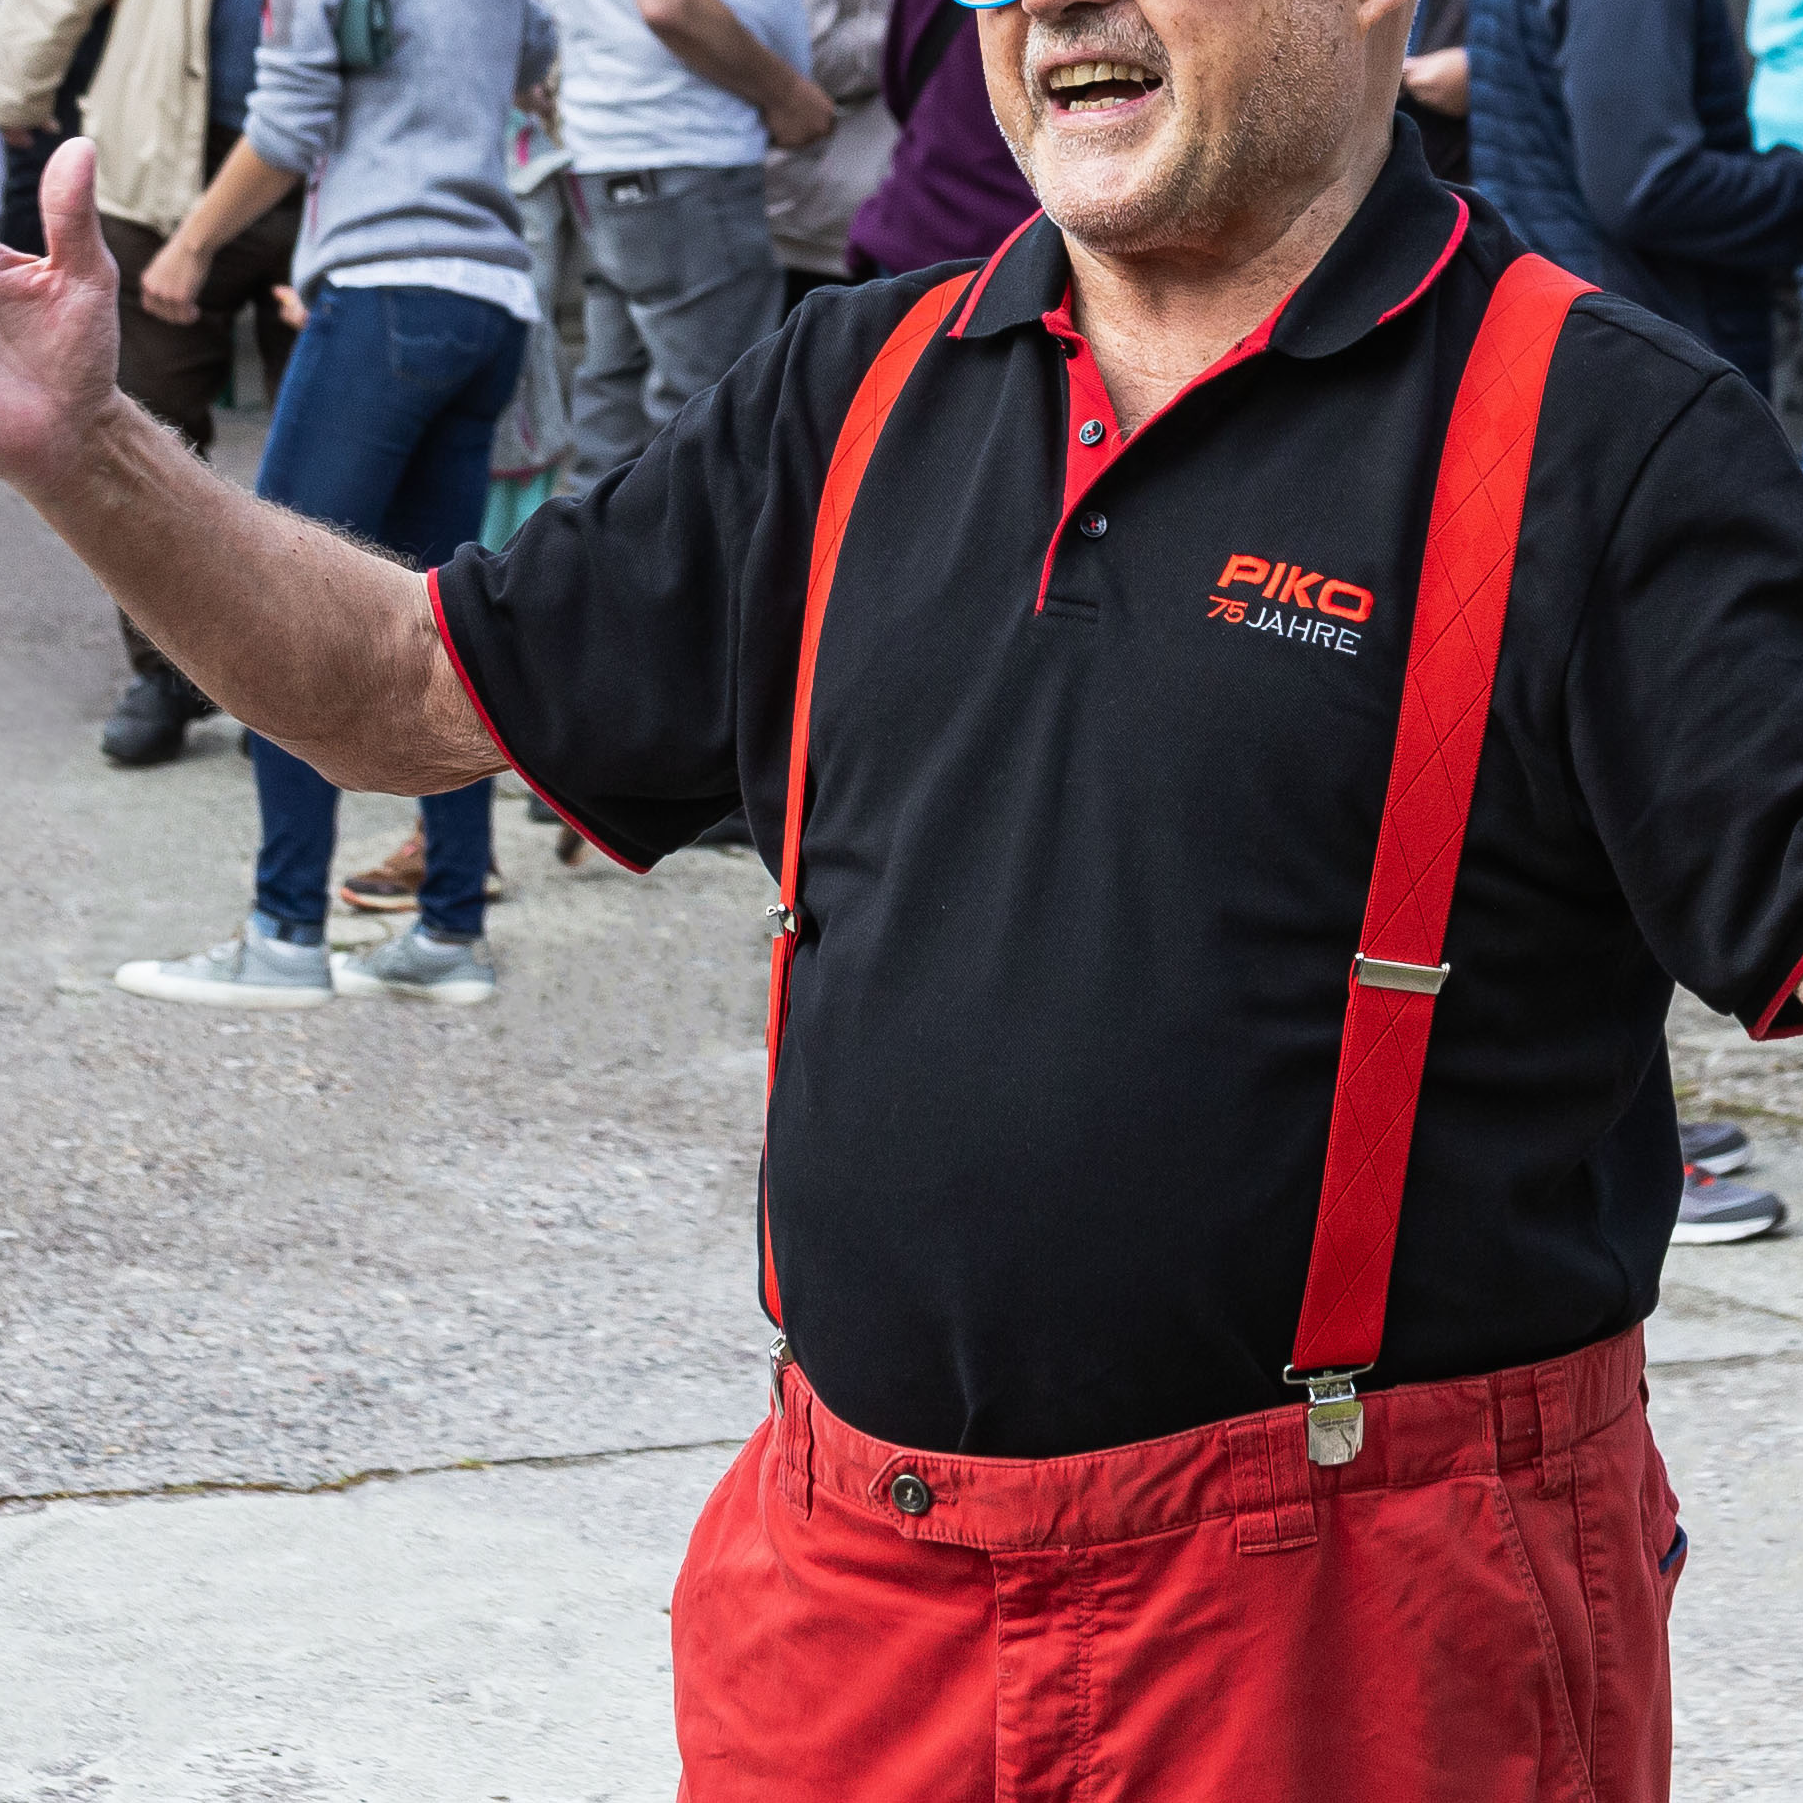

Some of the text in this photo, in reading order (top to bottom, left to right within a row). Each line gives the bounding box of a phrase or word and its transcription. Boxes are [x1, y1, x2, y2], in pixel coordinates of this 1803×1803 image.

[1216, 554, 1373, 623] PIKO
[1207, 595, 1362, 655] 75 JAHRE
